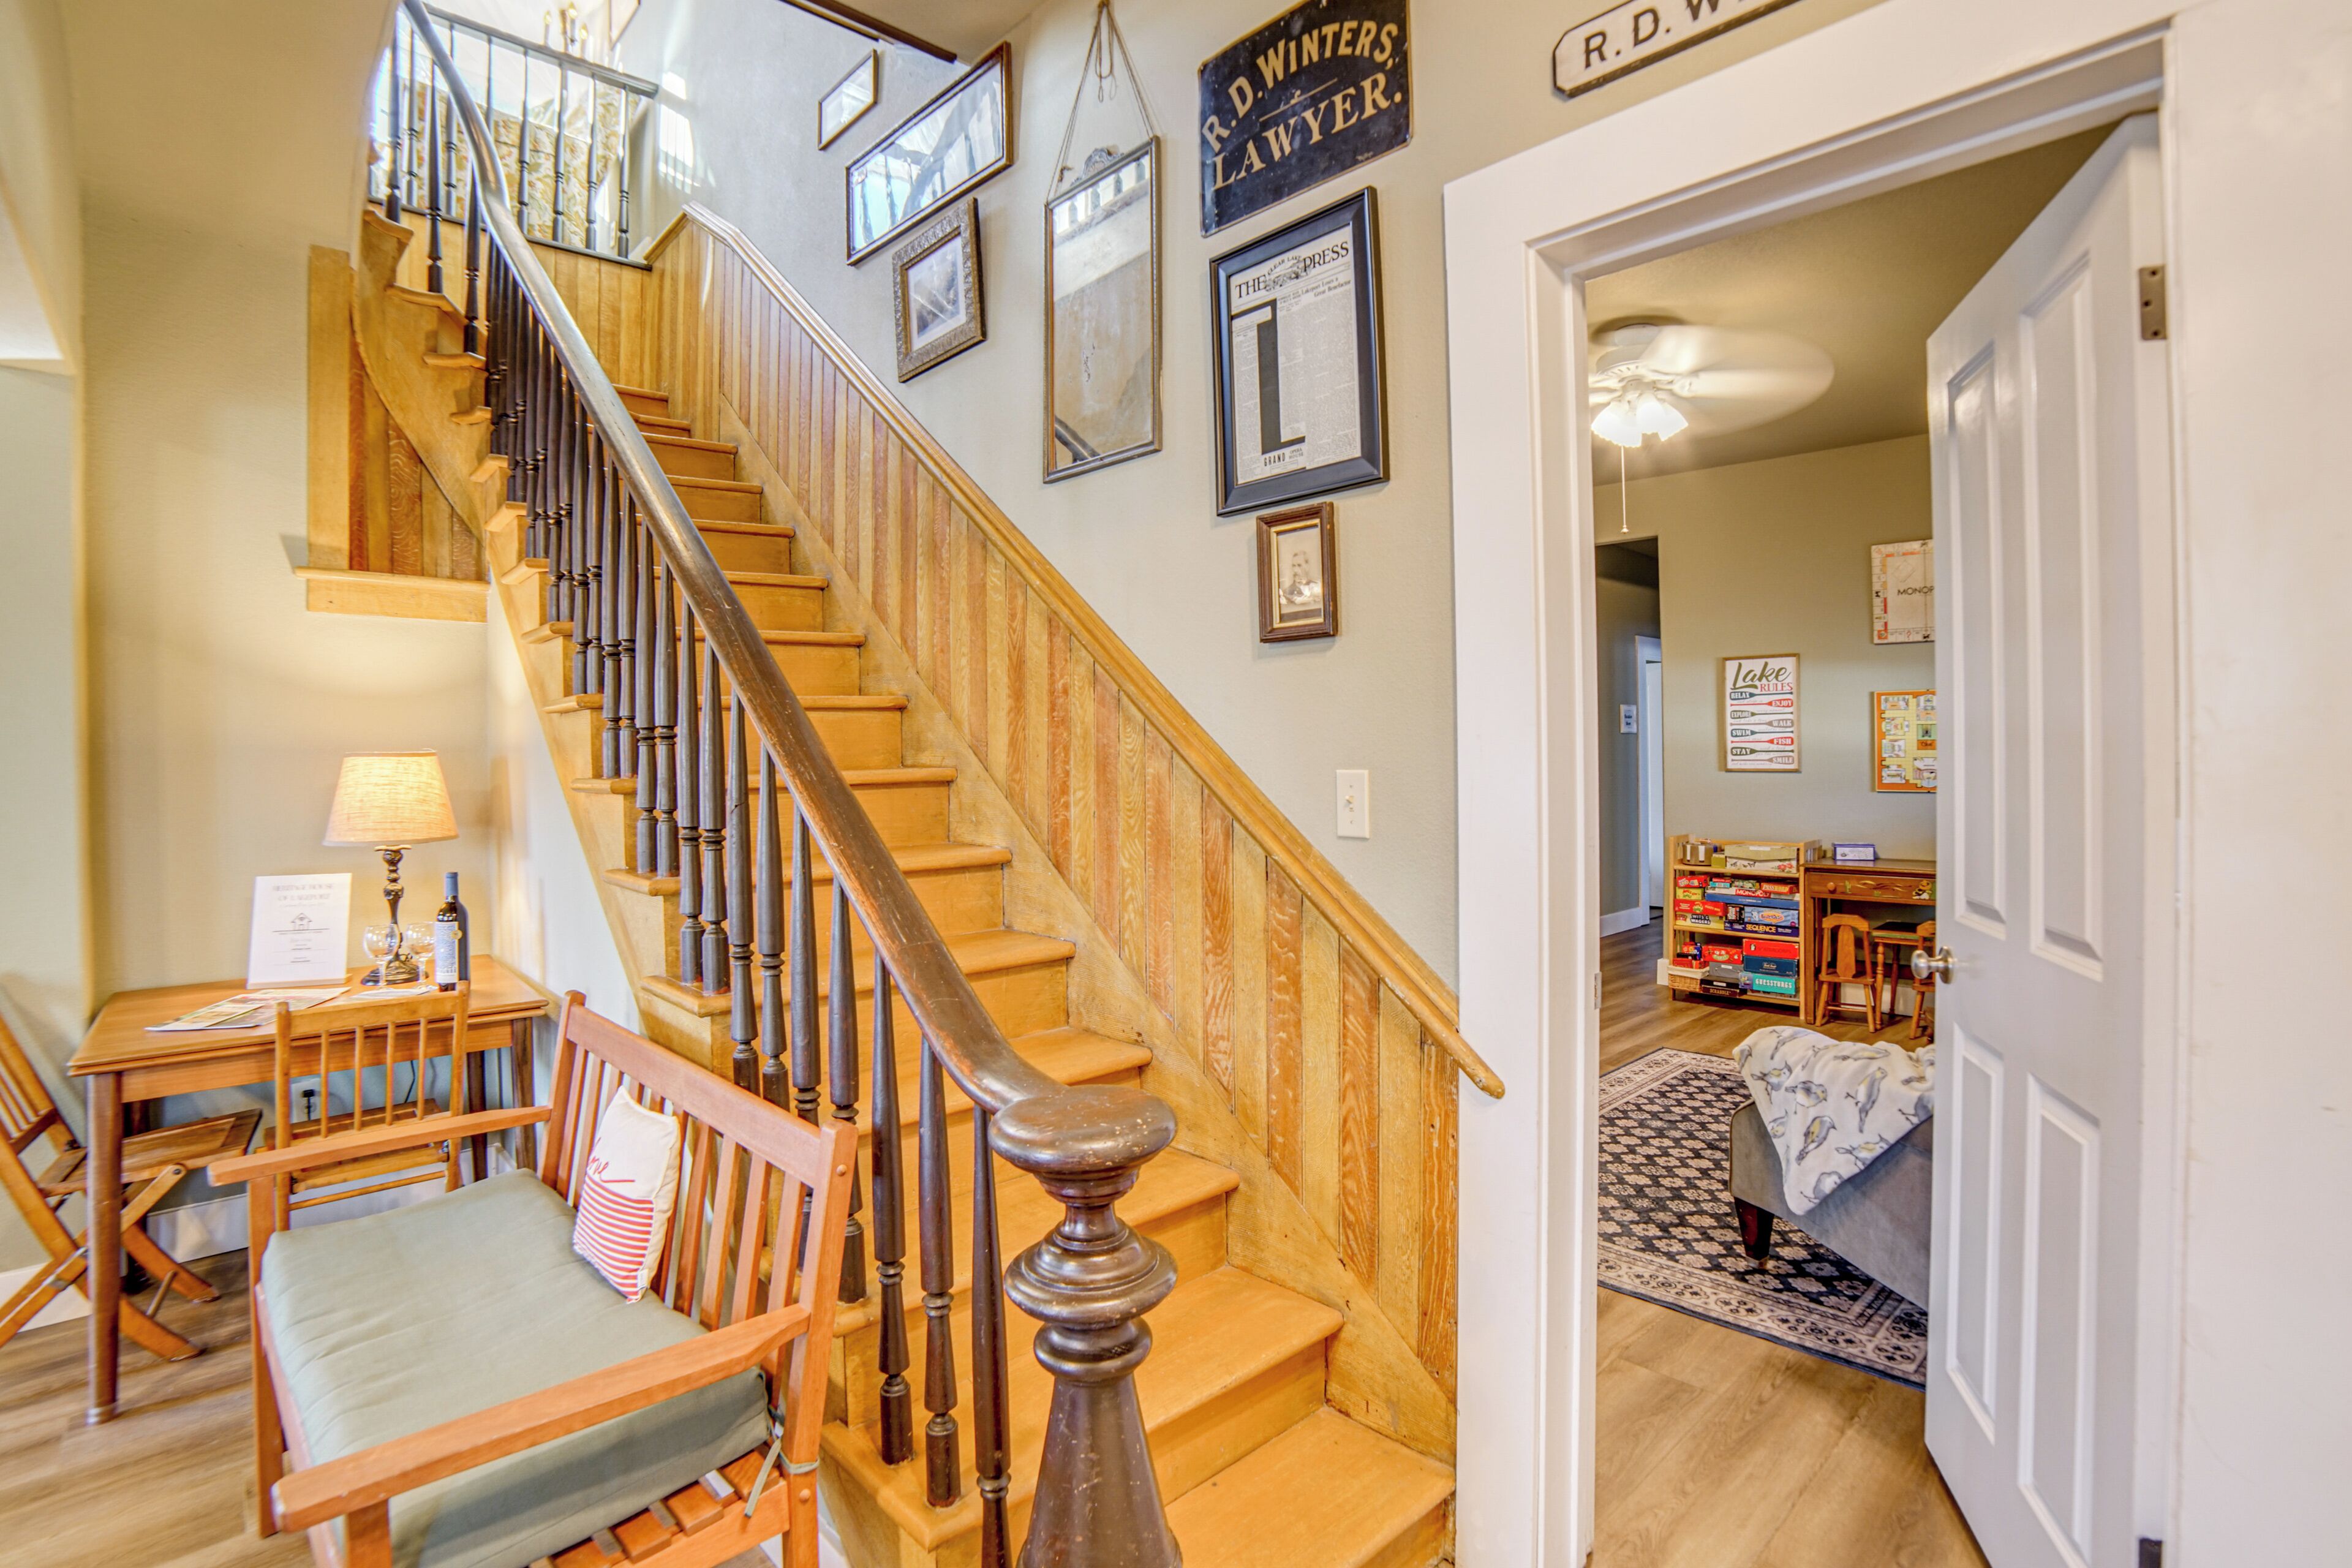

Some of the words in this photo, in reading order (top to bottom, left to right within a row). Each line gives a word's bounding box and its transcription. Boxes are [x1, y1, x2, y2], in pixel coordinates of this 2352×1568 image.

[1256, 20, 1398, 89] WINTERS,
[1212, 72, 1402, 191] LAWYER.
[1235, 274, 1267, 299] THE
[1302, 241, 1349, 272] PRESS
[1264, 453, 1286, 467] GRAND
[1730, 661, 1792, 691] Lake
[1760, 682, 1793, 692] RULES
[1746, 924, 1776, 933] SEQUENCE
[1755, 978, 1792, 989] GUESSTURES
